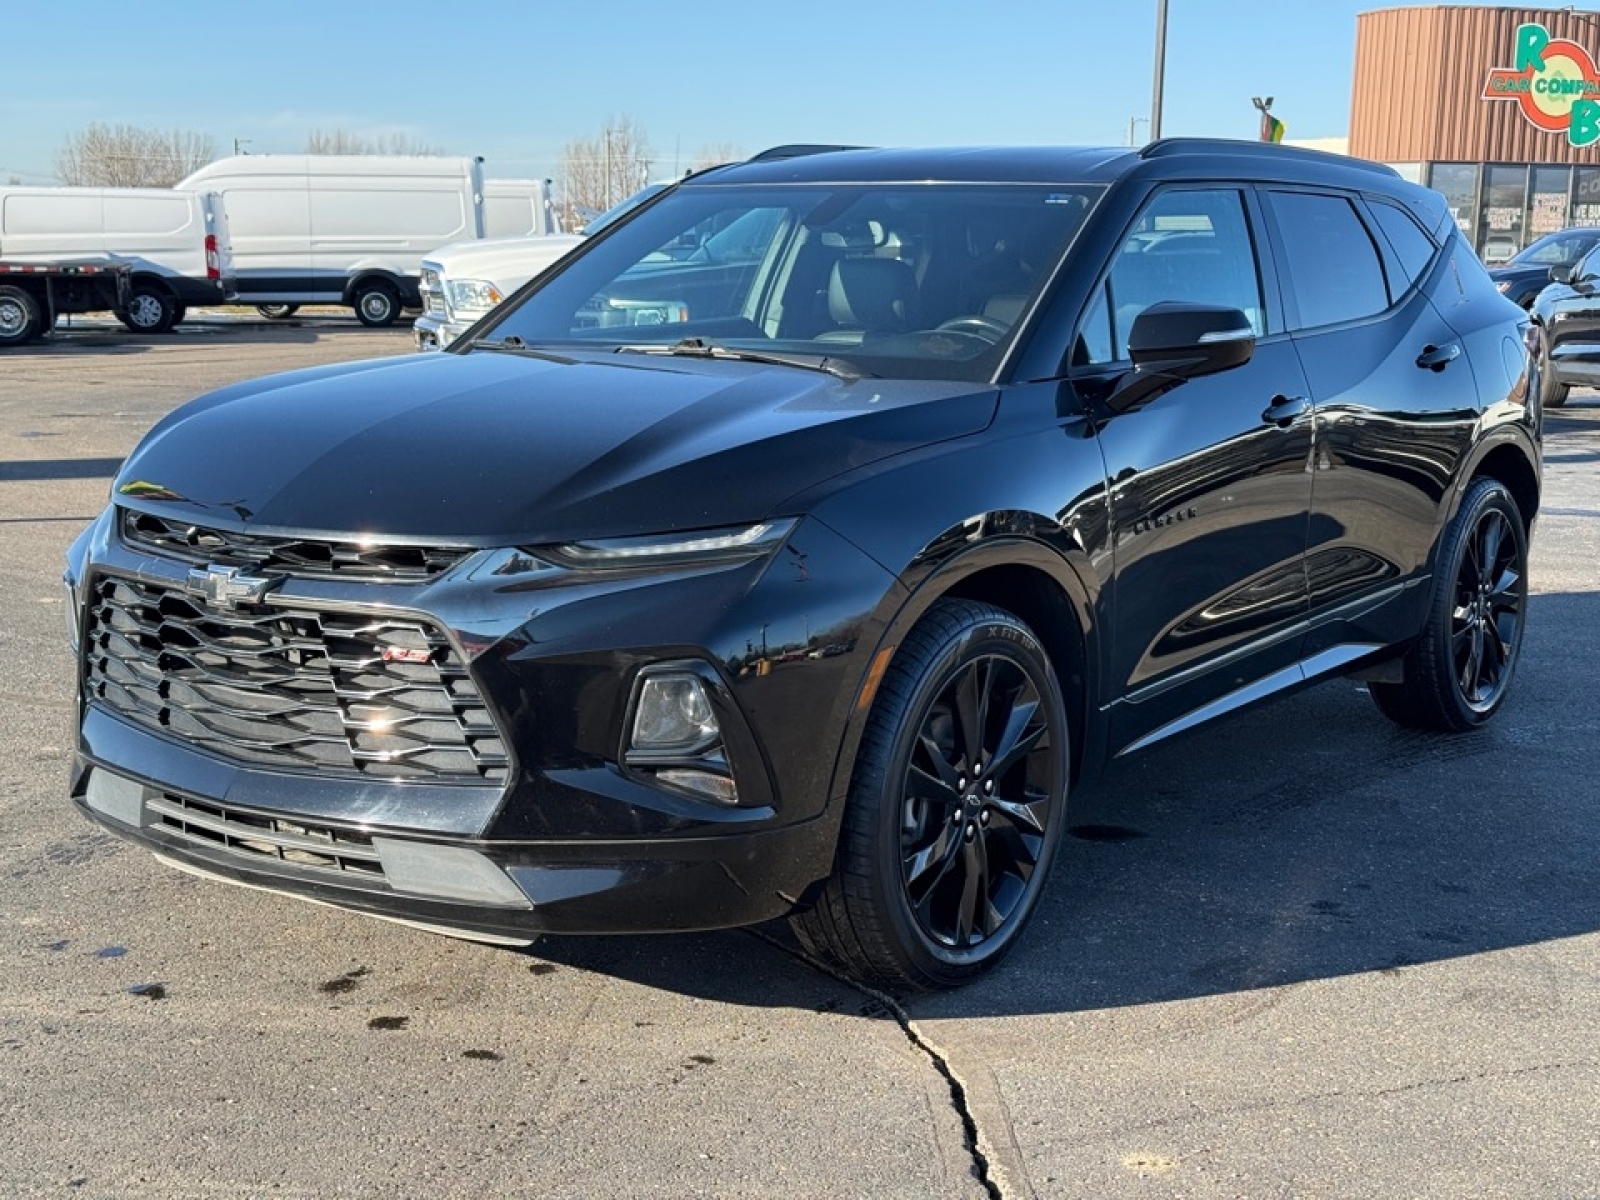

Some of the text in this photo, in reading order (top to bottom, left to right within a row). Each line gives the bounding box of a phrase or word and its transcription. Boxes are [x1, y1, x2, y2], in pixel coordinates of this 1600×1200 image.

[1516, 24, 1548, 73] R
[1492, 77, 1600, 95] CAR COMPA
[1568, 99, 1600, 146] B
